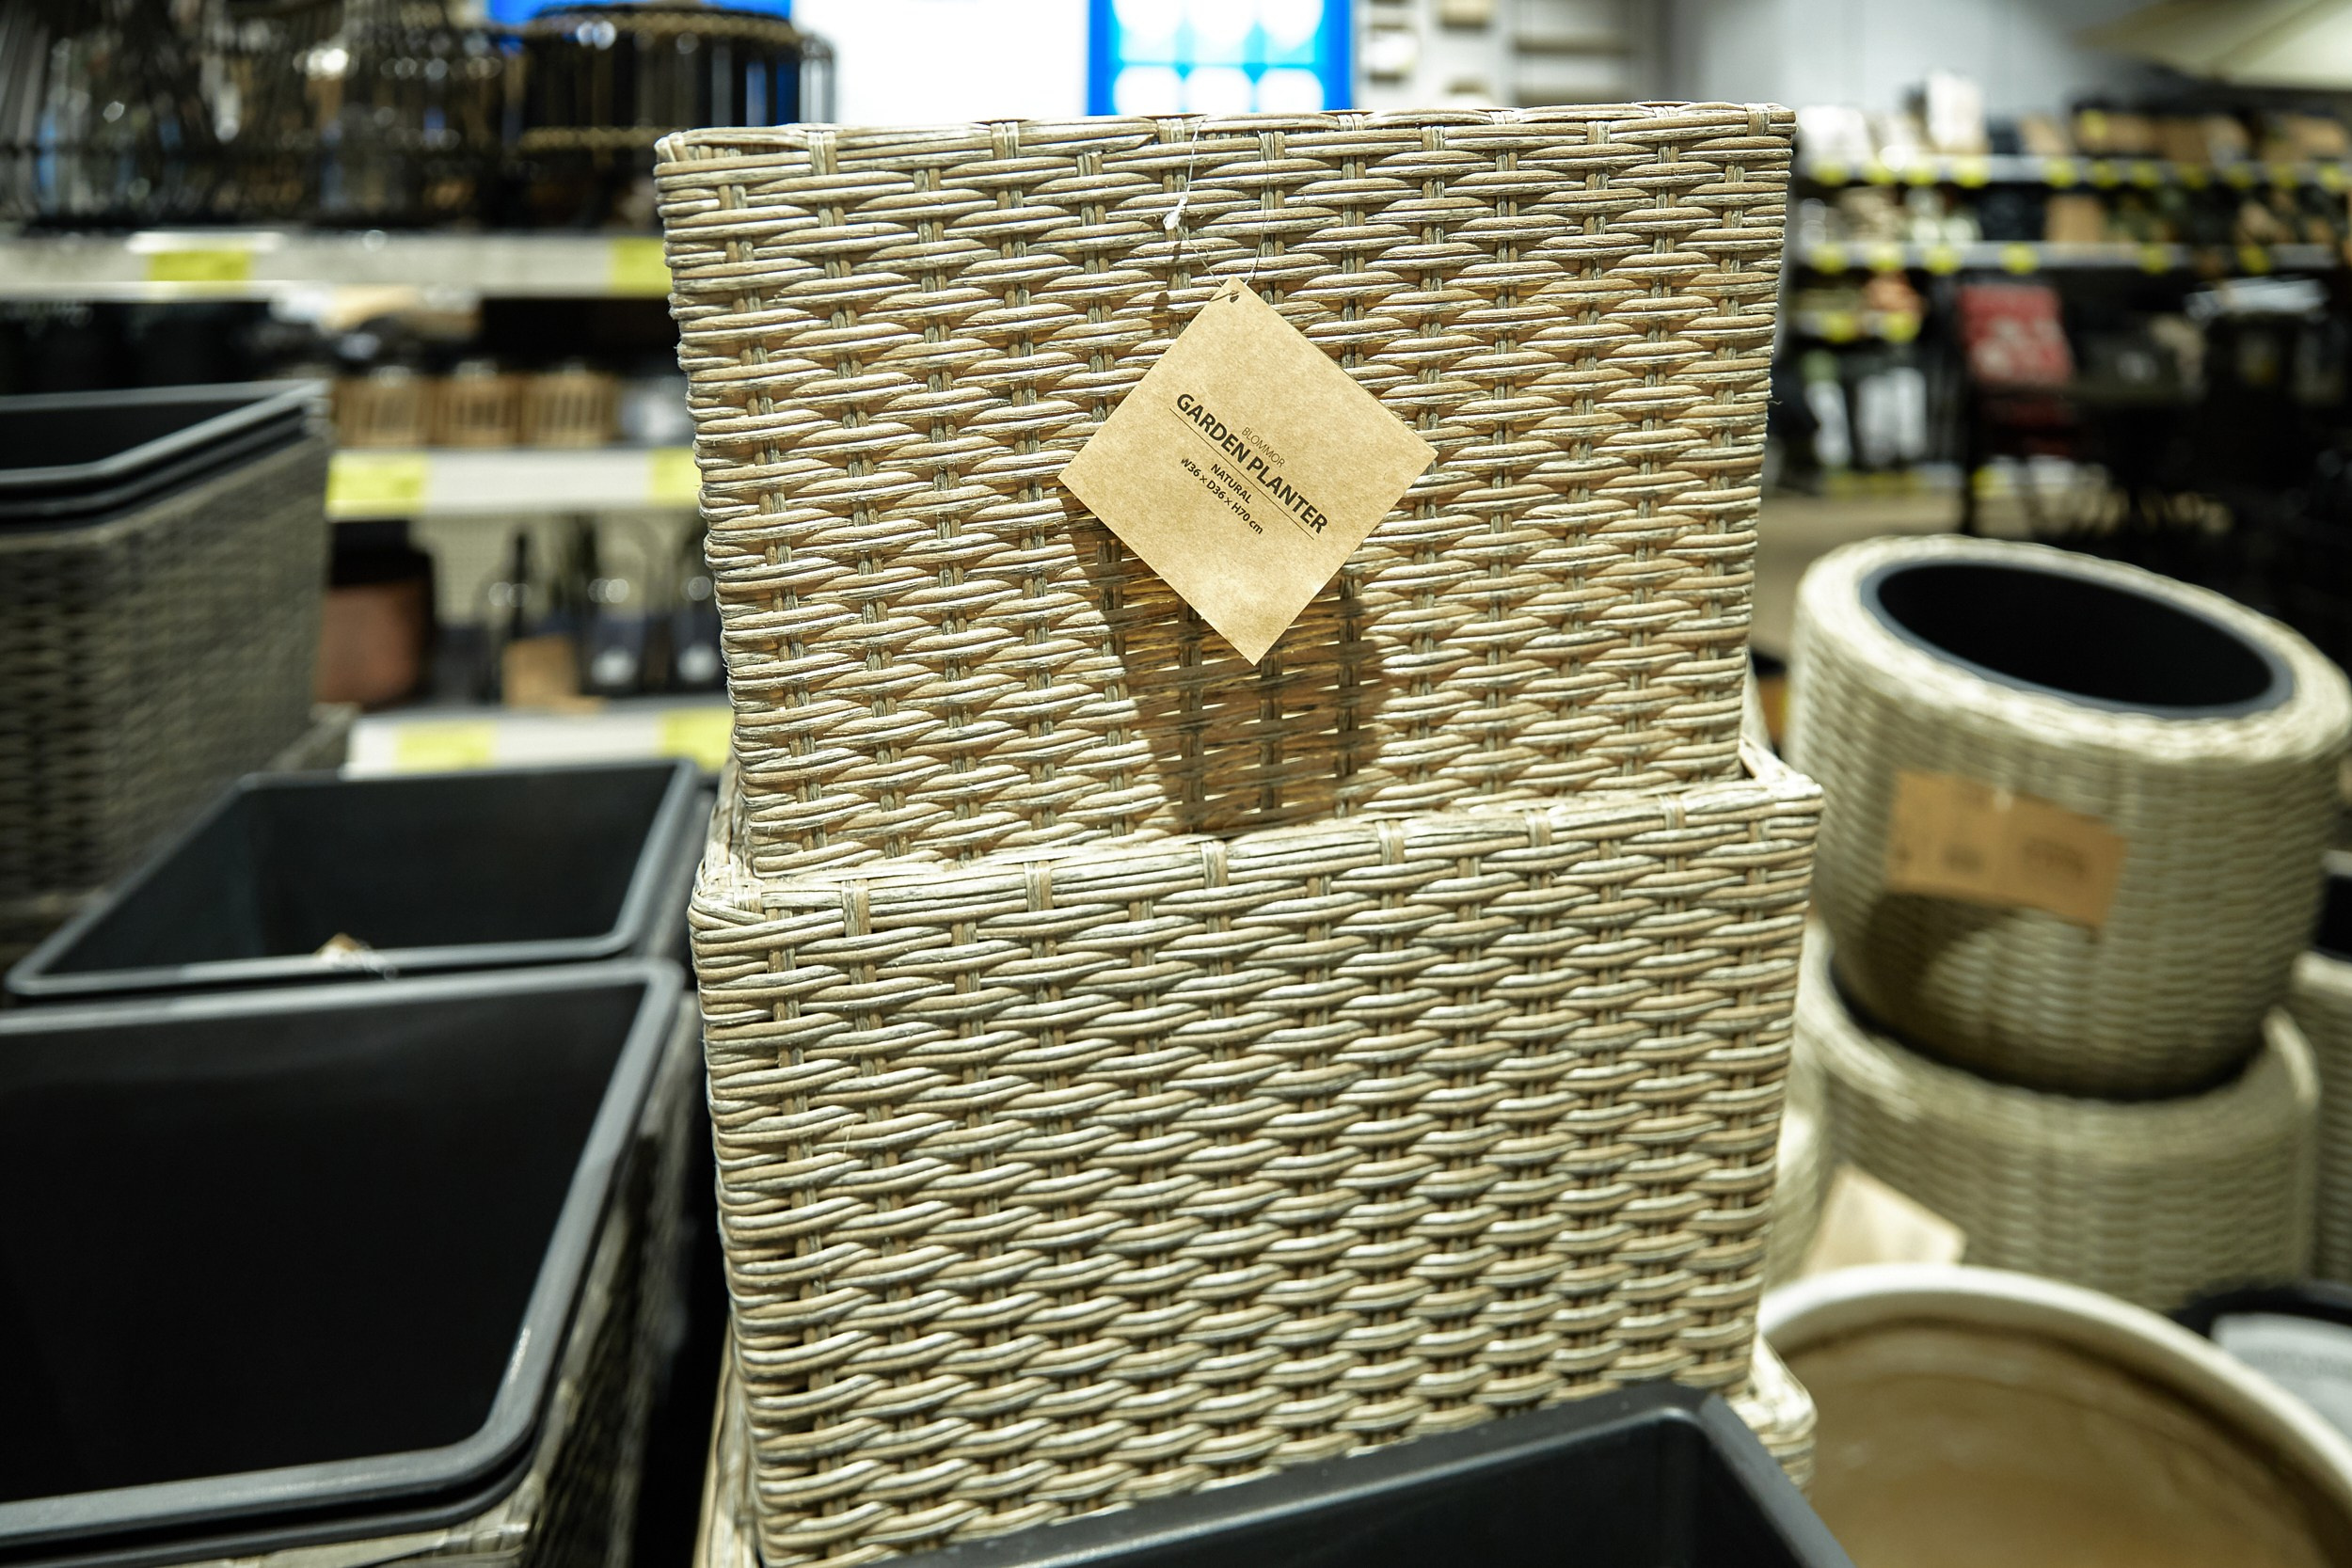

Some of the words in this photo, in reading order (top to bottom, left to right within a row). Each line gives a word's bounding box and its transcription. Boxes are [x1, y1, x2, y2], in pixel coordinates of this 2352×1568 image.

[1176, 393, 1251, 464] GARDEN
[1246, 455, 1328, 534] PLANTER
[1241, 426, 1286, 468] BLOMMOR
[1181, 457, 1201, 477] W36
[1206, 480, 1225, 499] D36
[1231, 502, 1250, 522] H70
[1249, 520, 1263, 534] cm
[1210, 463, 1252, 504] NATURAL
